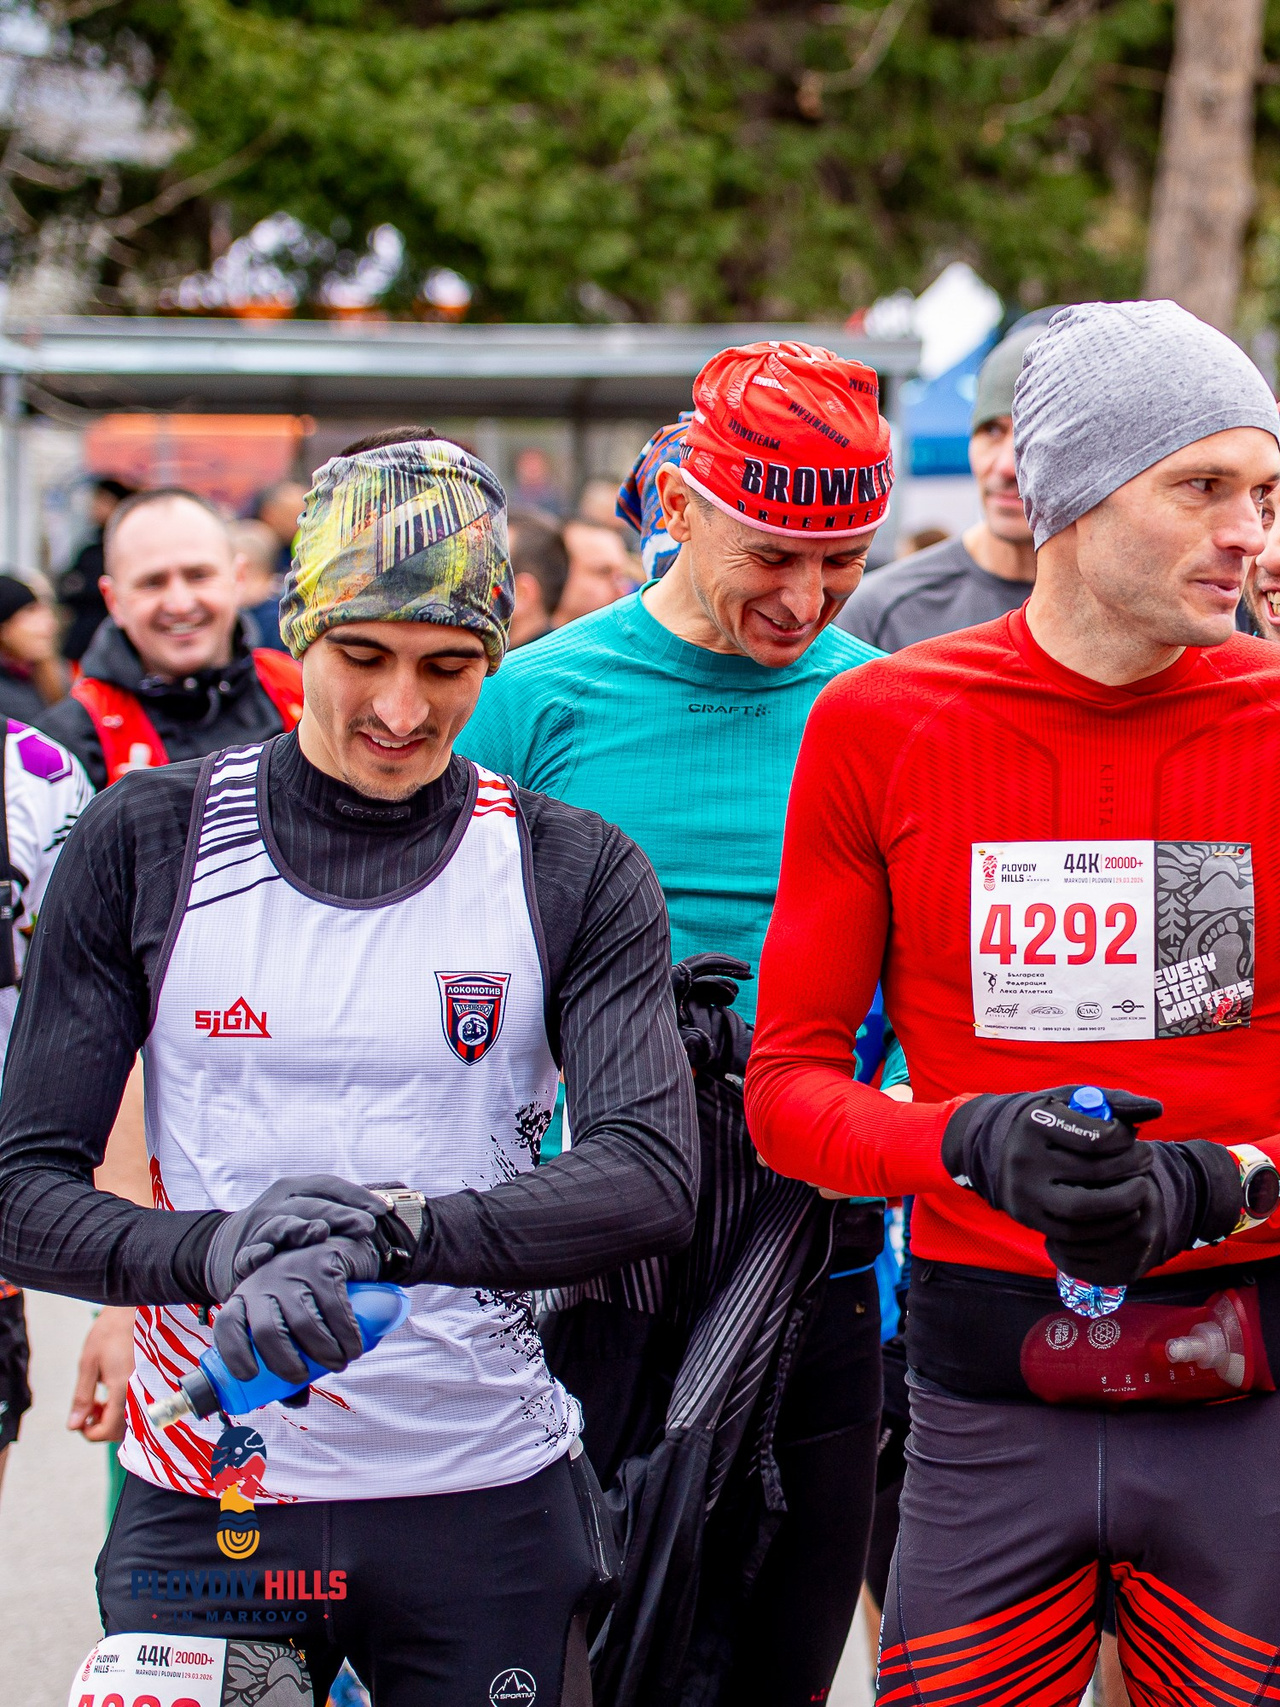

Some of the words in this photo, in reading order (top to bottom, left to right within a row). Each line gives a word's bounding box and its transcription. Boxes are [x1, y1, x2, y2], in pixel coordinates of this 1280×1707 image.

[741, 455, 893, 506] BROWNTE
[688, 703, 753, 715] CRAFT
[1099, 764, 1114, 826] KIPSTA
[1001, 863, 1037, 872] PLOVDIV
[1063, 853, 1100, 874] 44K
[1104, 856, 1144, 869] 2000D+
[1001, 874, 1024, 883] HILLS
[979, 902, 1137, 965] 4292
[1154, 952, 1217, 989] EVERY
[447, 986, 501, 995] ЛОКОМОТИВ
[1156, 975, 1208, 1008] STEP
[1161, 980, 1254, 1025] MATTERS
[1056, 1118, 1100, 1142] Kalenji
[96, 1654, 120, 1664] PLOVDIV
[136, 1645, 172, 1667] 44K
[175, 1651, 215, 1666] 2000D+
[93, 1664, 109, 1674] HILLS
[135, 1668, 158, 1677] MARKOVO
[161, 1670, 182, 1678] PLOVDIV
[500, 1691, 536, 1700] SPORTIVA
